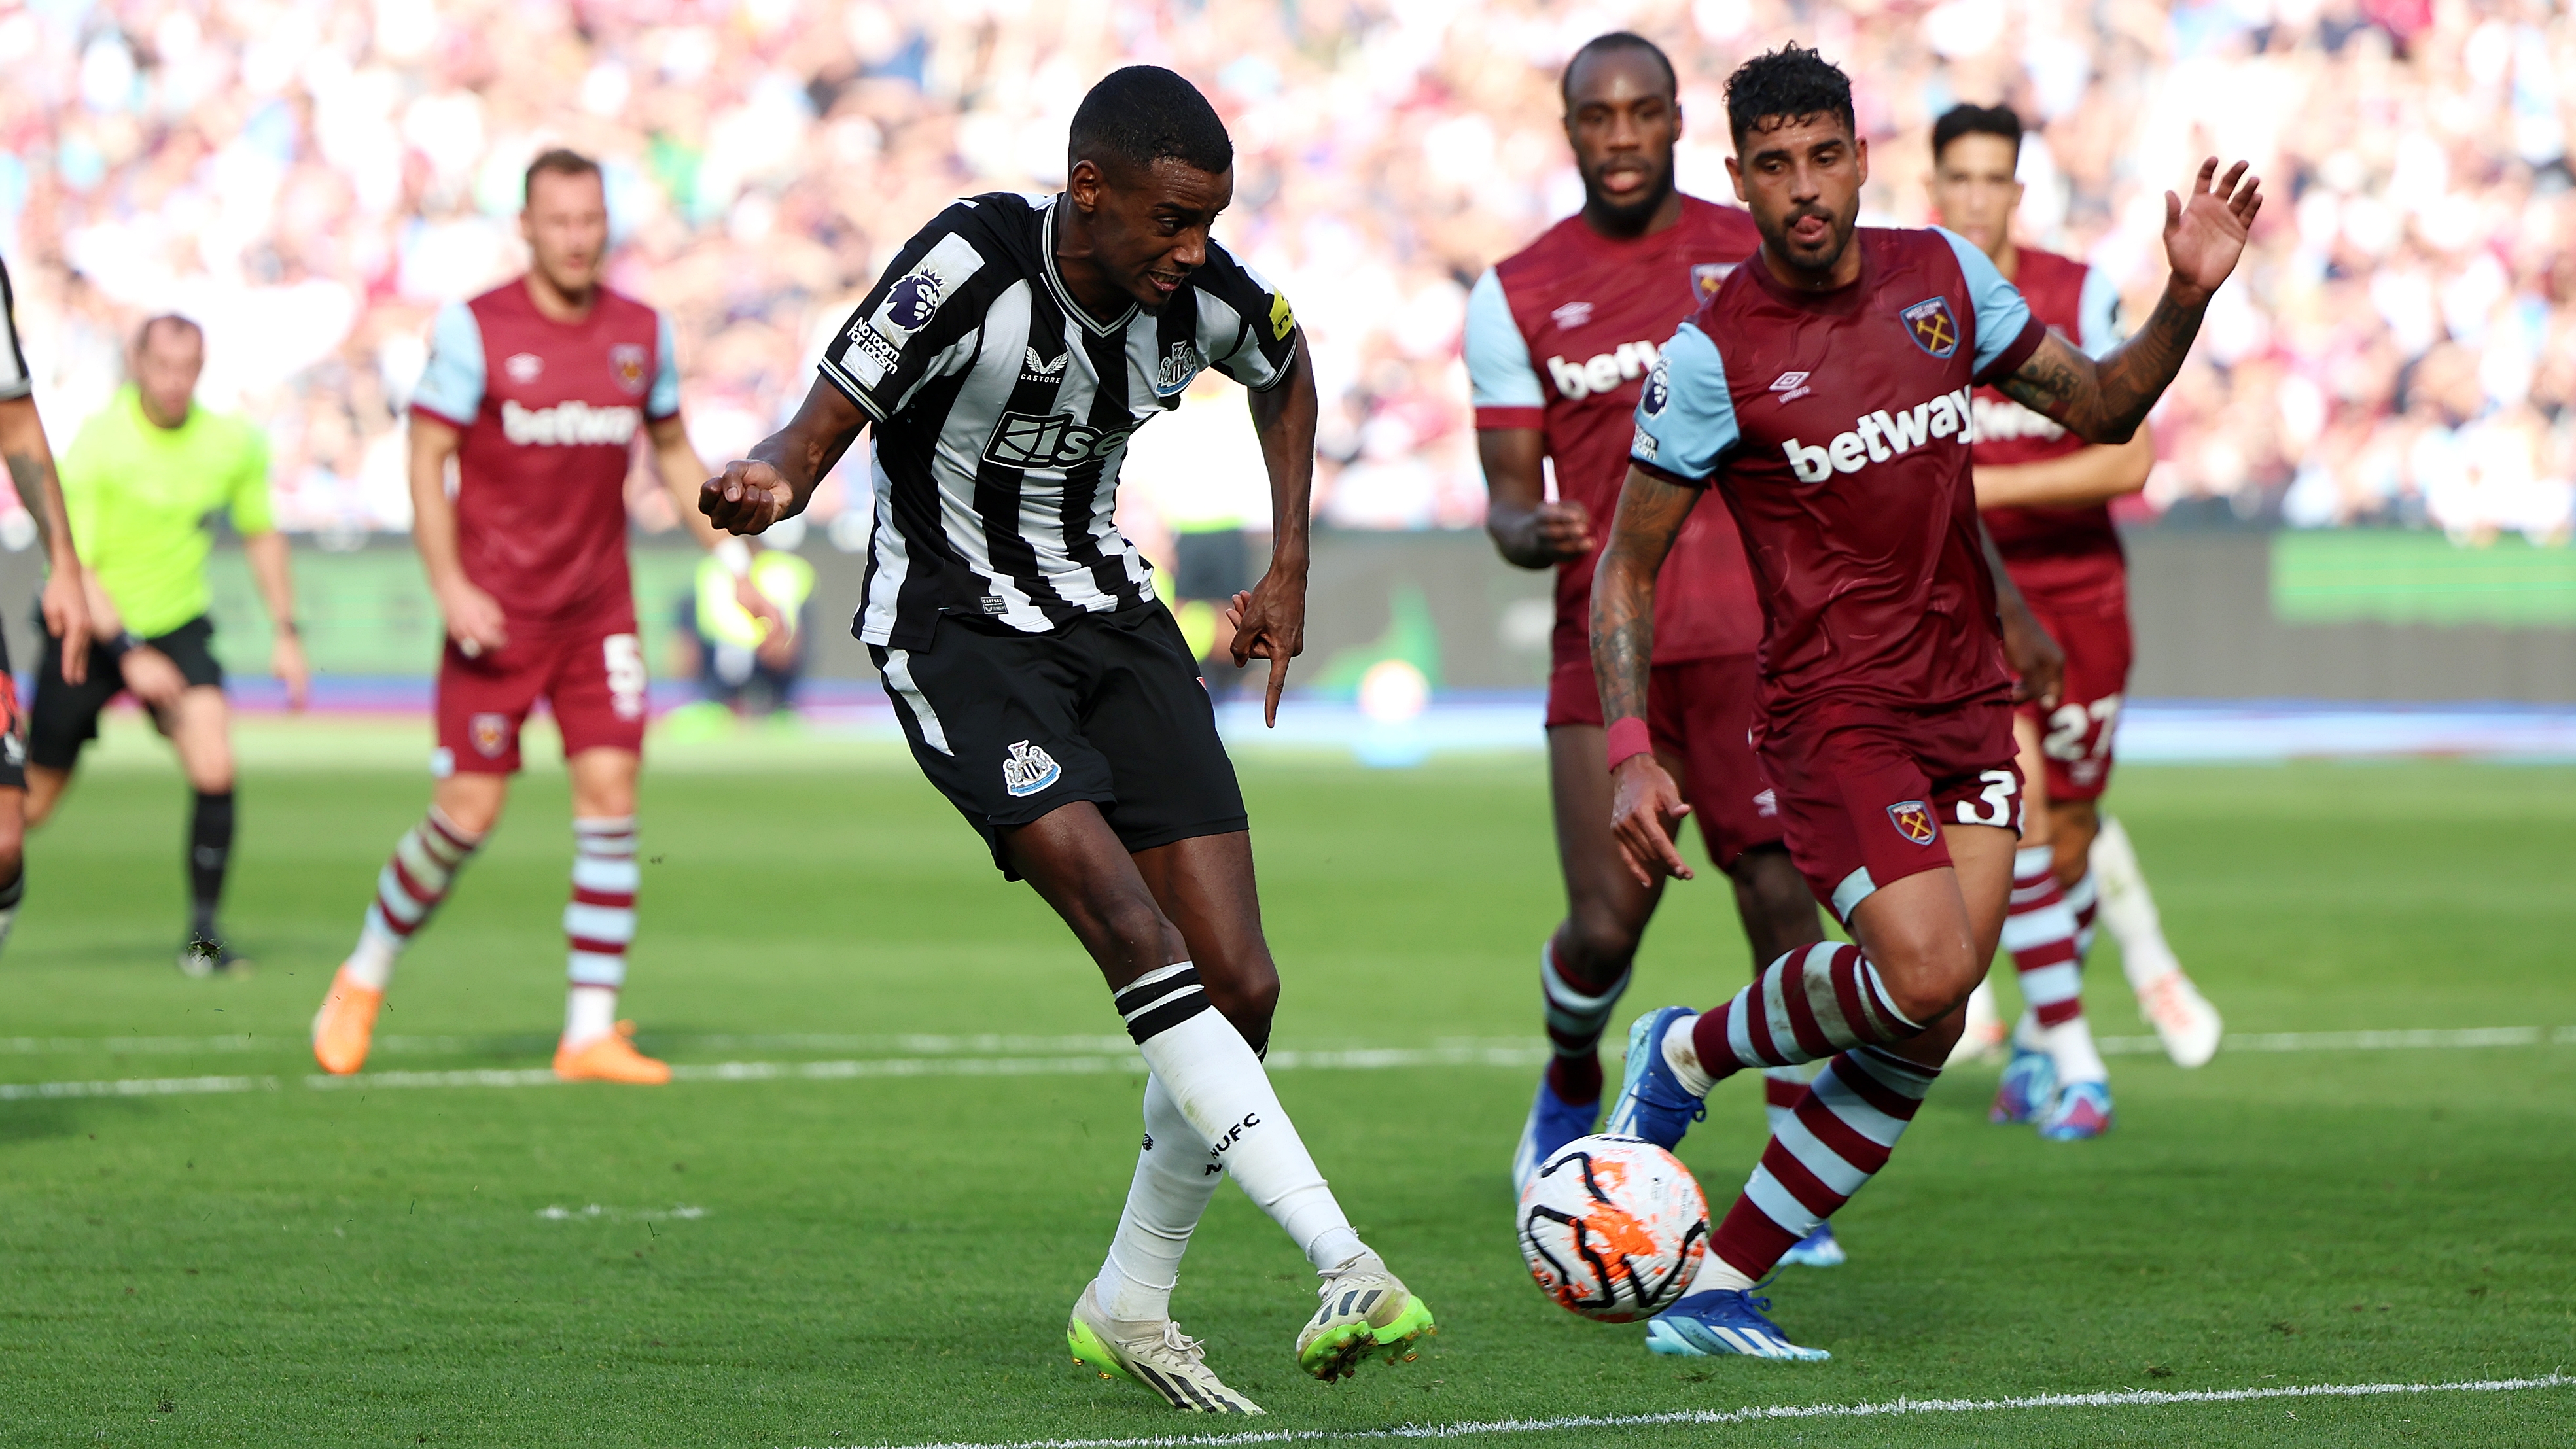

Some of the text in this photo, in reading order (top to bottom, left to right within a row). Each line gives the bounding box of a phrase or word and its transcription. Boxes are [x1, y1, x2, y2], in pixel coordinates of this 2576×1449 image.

[854, 316, 900, 362] No room
[861, 340, 898, 375] racism
[1021, 374, 1061, 384] CASTORE
[501, 398, 643, 447] betway
[1781, 383, 1973, 483] betway
[602, 632, 647, 694] 5
[2043, 702, 2121, 761] 27
[1956, 769, 2026, 837] 3
[1210, 1112, 1261, 1159] NUFC
